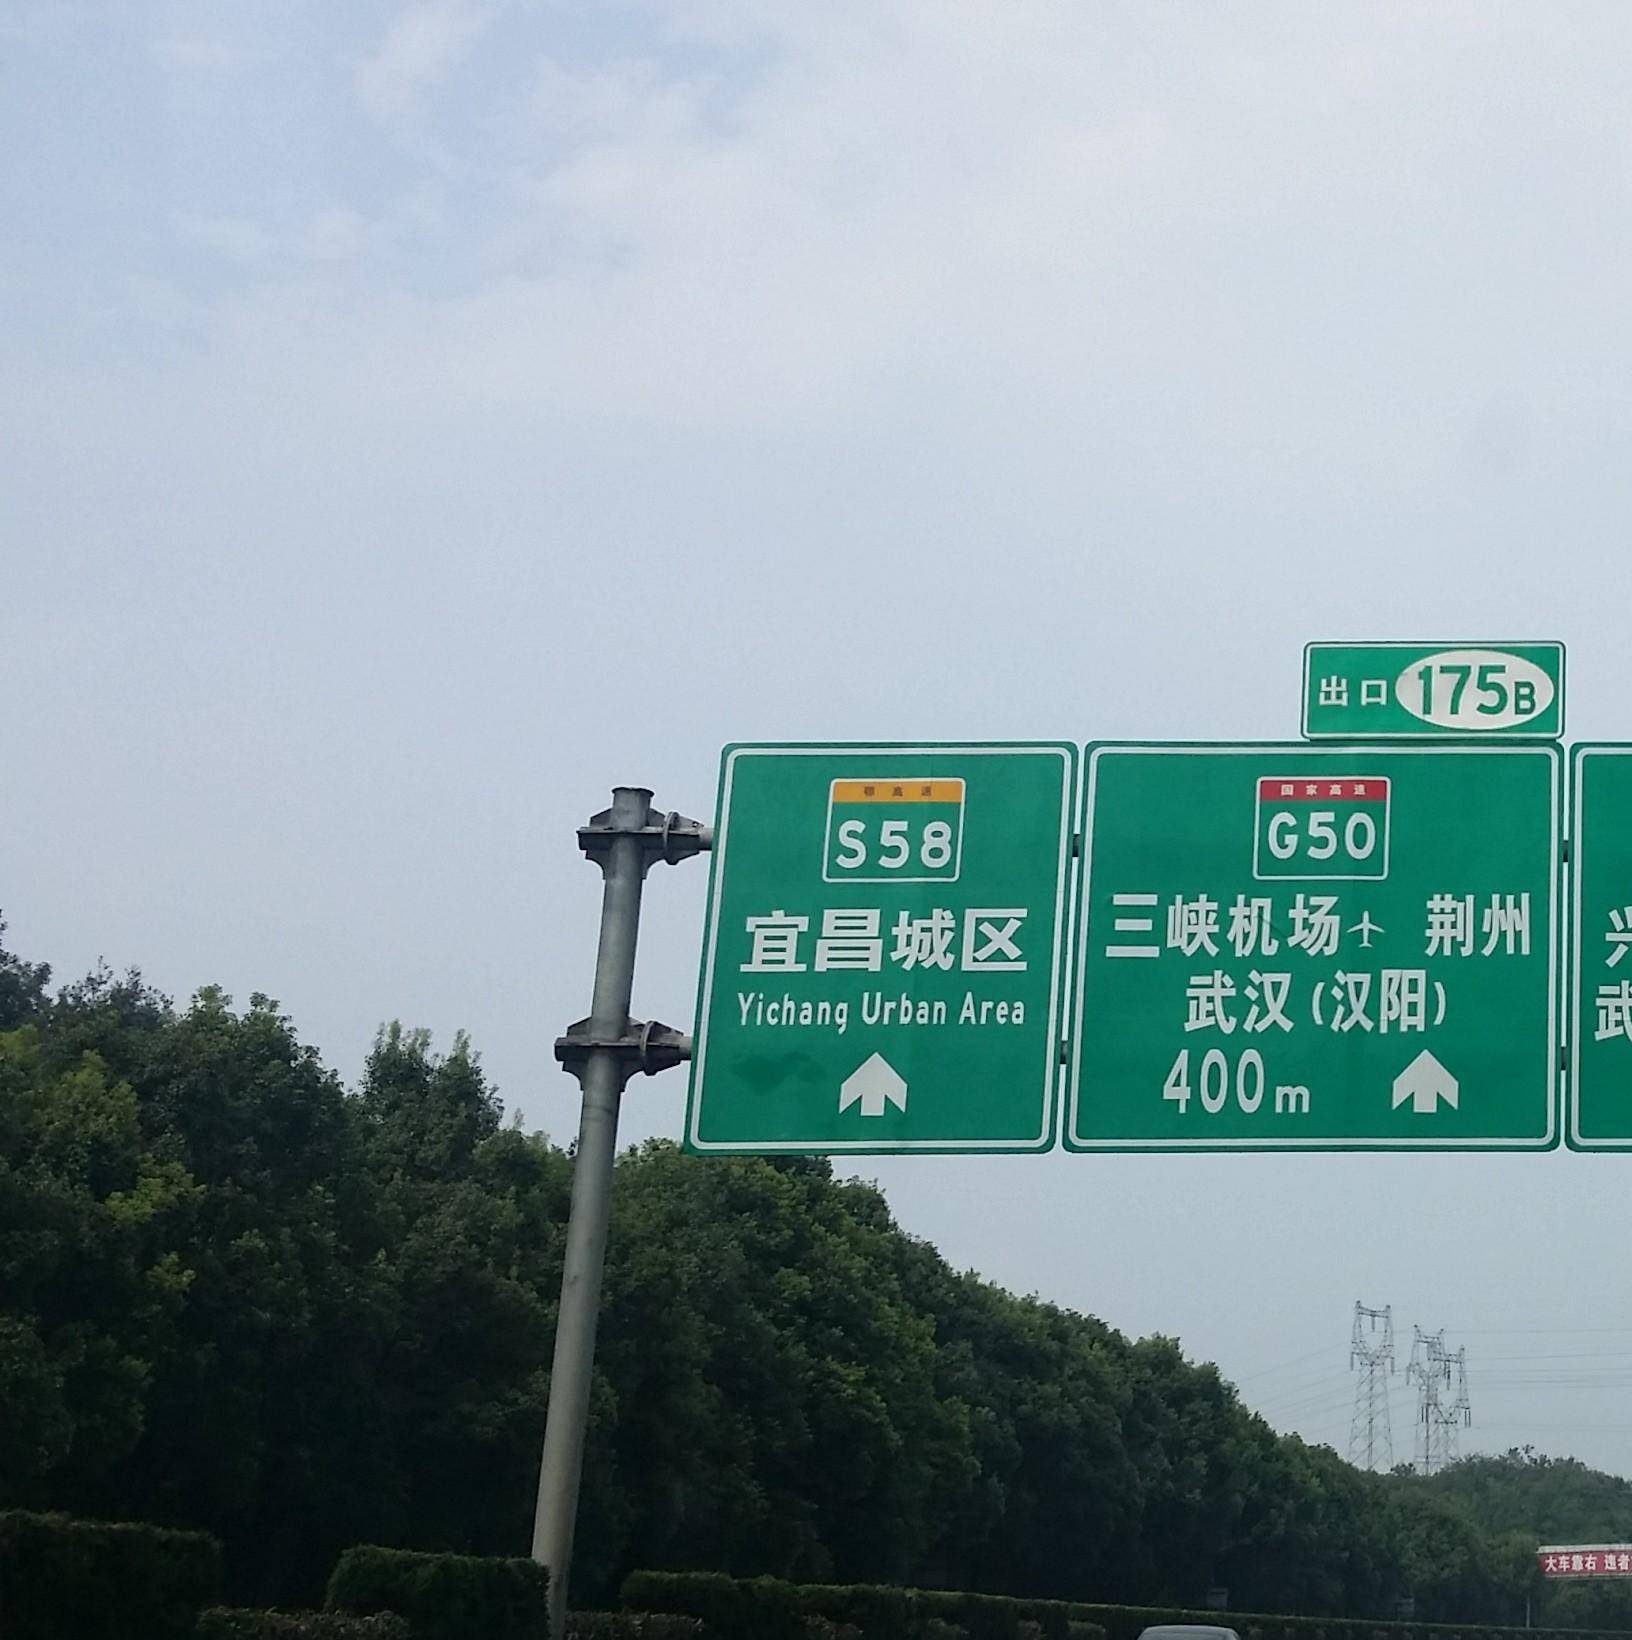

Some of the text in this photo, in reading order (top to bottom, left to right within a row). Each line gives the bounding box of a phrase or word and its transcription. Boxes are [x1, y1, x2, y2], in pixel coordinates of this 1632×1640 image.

[1319, 665, 1536, 716] 出口 175B
[836, 820, 952, 869] S58
[1268, 812, 1376, 860] G50
[740, 909, 1027, 972] 宜昌城区
[1106, 893, 1530, 957] 三峡机场 荆州
[738, 992, 1025, 1034] Yichang Urban Area
